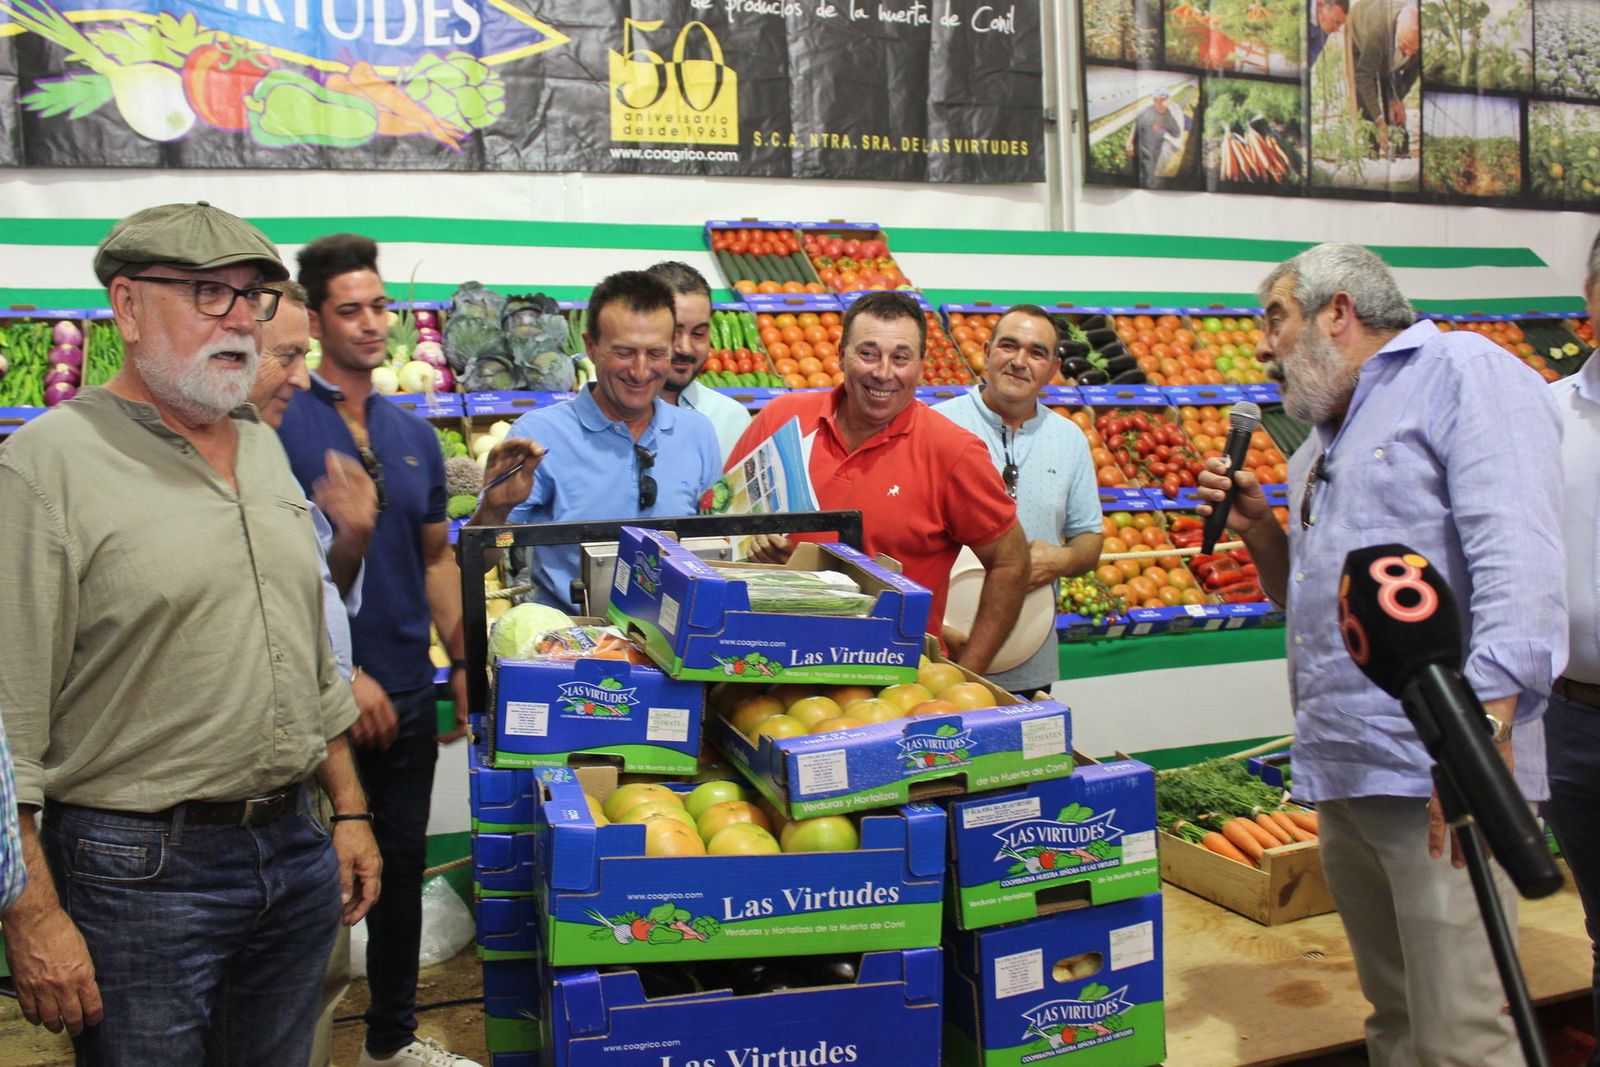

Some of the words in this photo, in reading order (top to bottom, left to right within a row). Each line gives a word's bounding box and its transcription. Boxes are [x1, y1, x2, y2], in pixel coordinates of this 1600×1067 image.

[725, 0, 804, 23] productos
[815, 0, 838, 18] de
[849, 0, 869, 21] la
[878, 4, 931, 26] huerta
[940, 0, 961, 28] de
[971, 5, 1015, 34] Conil
[615, 17, 725, 112] 50
[624, 112, 728, 125] aniversario
[623, 125, 679, 137] desde
[686, 126, 728, 138] 1963
[753, 131, 803, 148] S.C.A.
[810, 133, 857, 149] NTRA.
[862, 135, 897, 151] SRA.
[954, 139, 1029, 155] VIRTUDES
[609, 148, 738, 163] www.coagrico.com
[1369, 555, 1439, 623] 8
[719, 638, 786, 648] www.coagrico.com
[791, 649, 823, 666] Las
[829, 646, 905, 665] Virtudes
[567, 686, 584, 696] LAS
[585, 687, 628, 703] VIRTUDES
[905, 740, 923, 751] LAS
[924, 737, 966, 750] VIRTUDES
[976, 776, 988, 786] de
[990, 774, 999, 784] la
[1001, 770, 1029, 783] Huerta
[1031, 769, 1043, 779] de
[1046, 764, 1067, 776] Conil
[802, 800, 843, 812] Verduras
[854, 791, 899, 804] Hortalizas
[1010, 827, 1034, 847] LAS
[1036, 822, 1105, 844] VIRTUDES
[627, 890, 703, 901] www.coagrico.com
[722, 896, 774, 921] Las
[781, 881, 900, 912] Virtudes
[725, 927, 763, 937] Verduras
[772, 926, 814, 935] Hortalizas
[829, 924, 837, 932] la
[839, 922, 868, 931] Huerta
[869, 921, 881, 929] de
[883, 920, 906, 929] Conil
[1037, 1006, 1059, 1026] LAS
[1060, 999, 1119, 1020] VIRTUDES
[603, 1038, 680, 1052] www.coagrico.com
[726, 1041, 858, 1067] Virtudes
